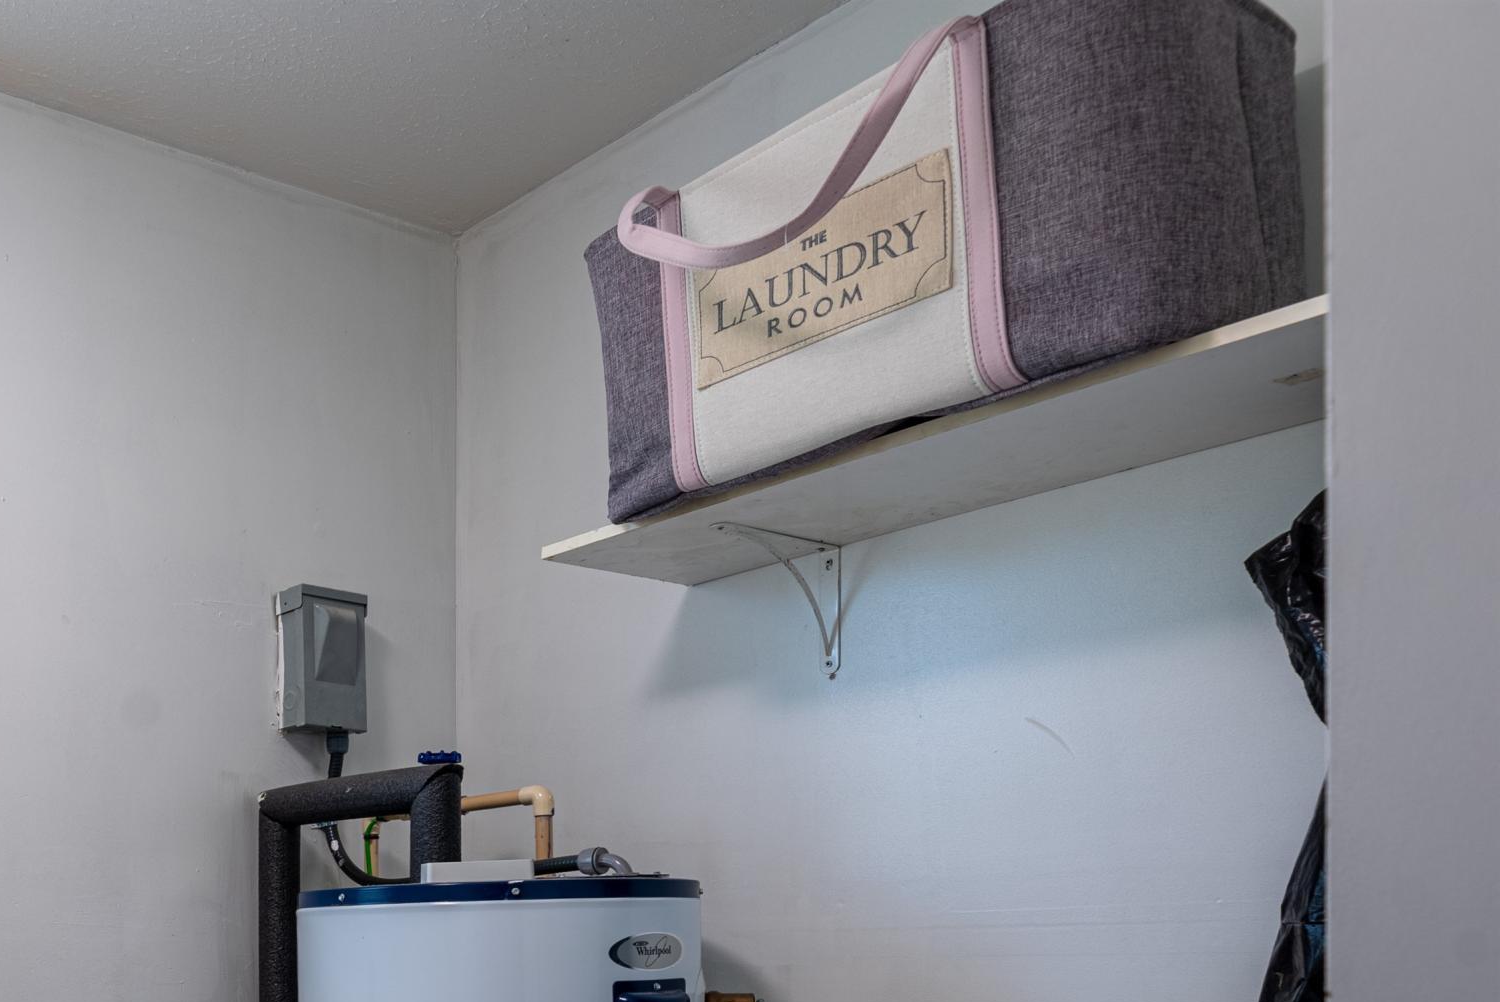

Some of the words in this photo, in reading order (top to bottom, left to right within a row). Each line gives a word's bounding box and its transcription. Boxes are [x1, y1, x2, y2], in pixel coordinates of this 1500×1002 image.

[800, 229, 827, 252] THE
[712, 210, 927, 334] LAUNDRY
[766, 283, 863, 338] ROOM
[635, 943, 672, 960] Whirlpool
